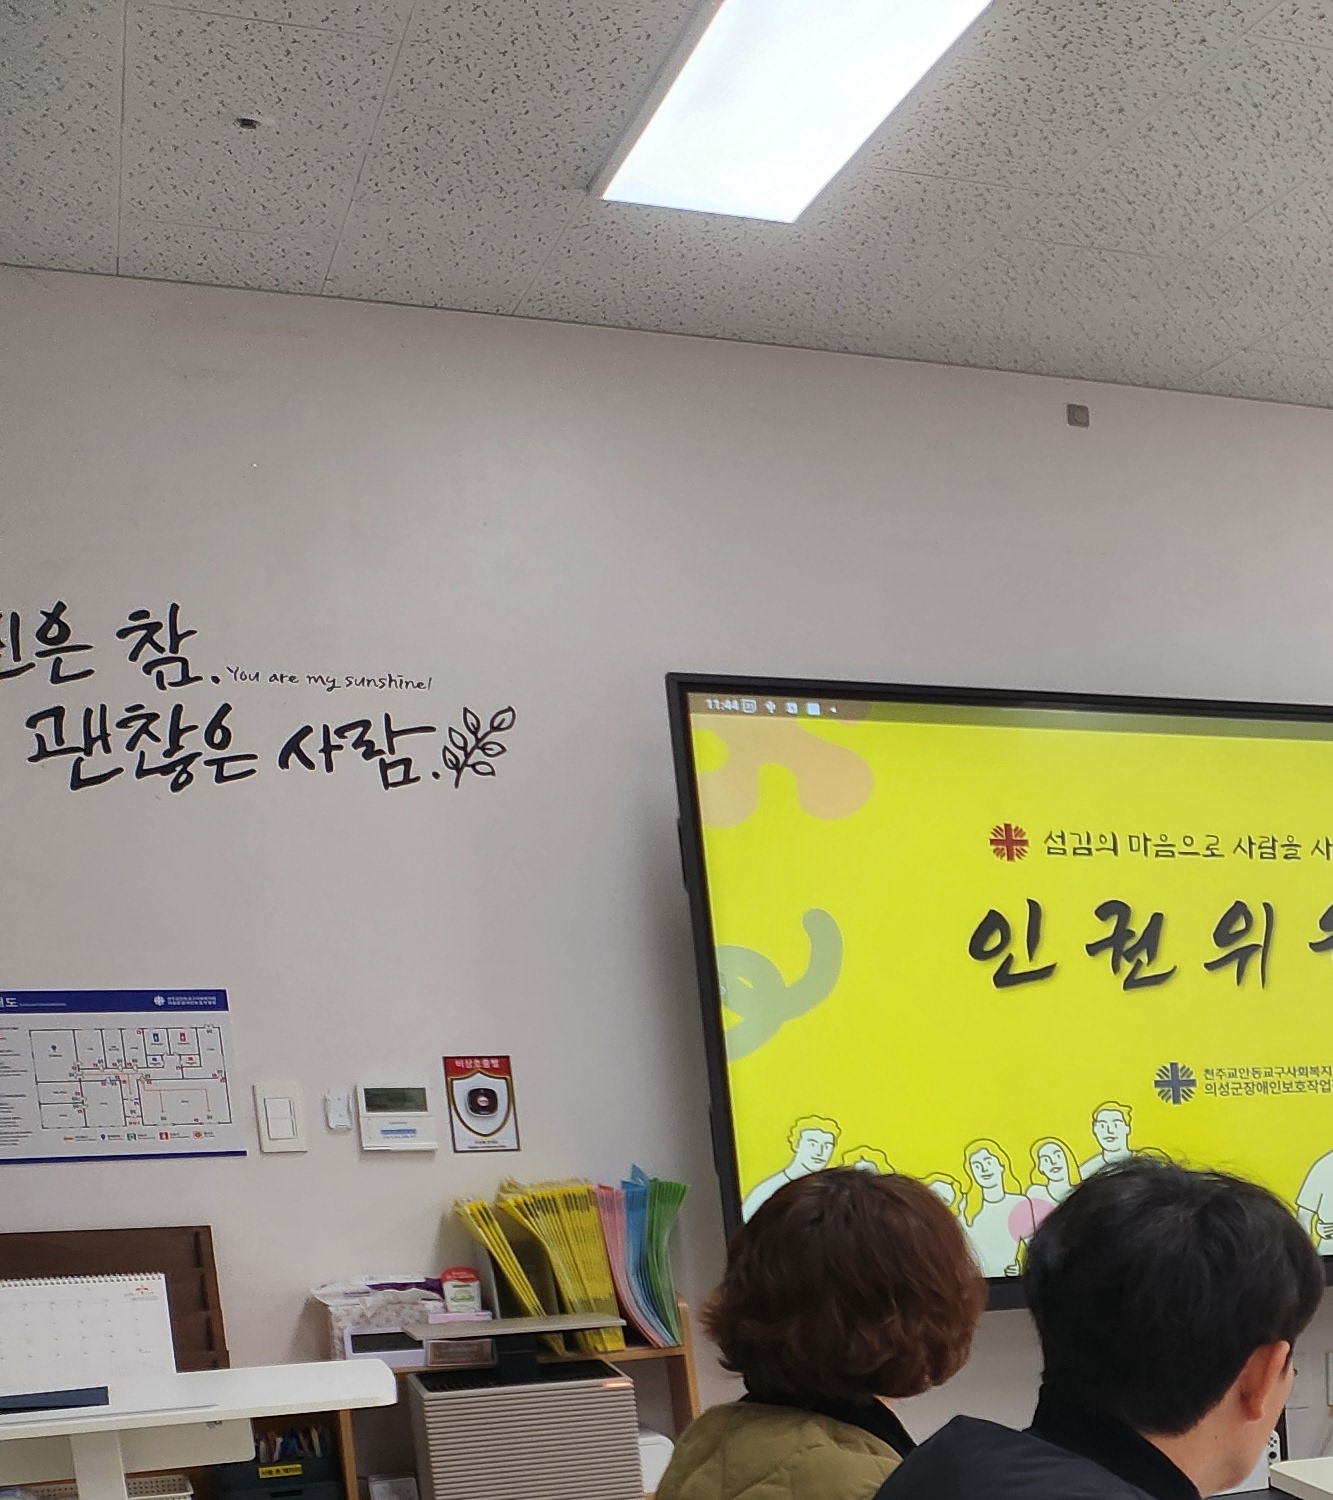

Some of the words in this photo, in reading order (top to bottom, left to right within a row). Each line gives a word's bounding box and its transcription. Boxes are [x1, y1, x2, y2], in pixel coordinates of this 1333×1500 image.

[226, 666, 260, 683] You
[268, 672, 300, 684] are
[306, 674, 342, 692] my
[25, 703, 258, 793] 괜찮은
[278, 712, 441, 791] 사람.
[1043, 829, 1120, 859] 섬김의
[1128, 831, 1225, 860] 마음으로
[1233, 834, 1303, 861] 사람을
